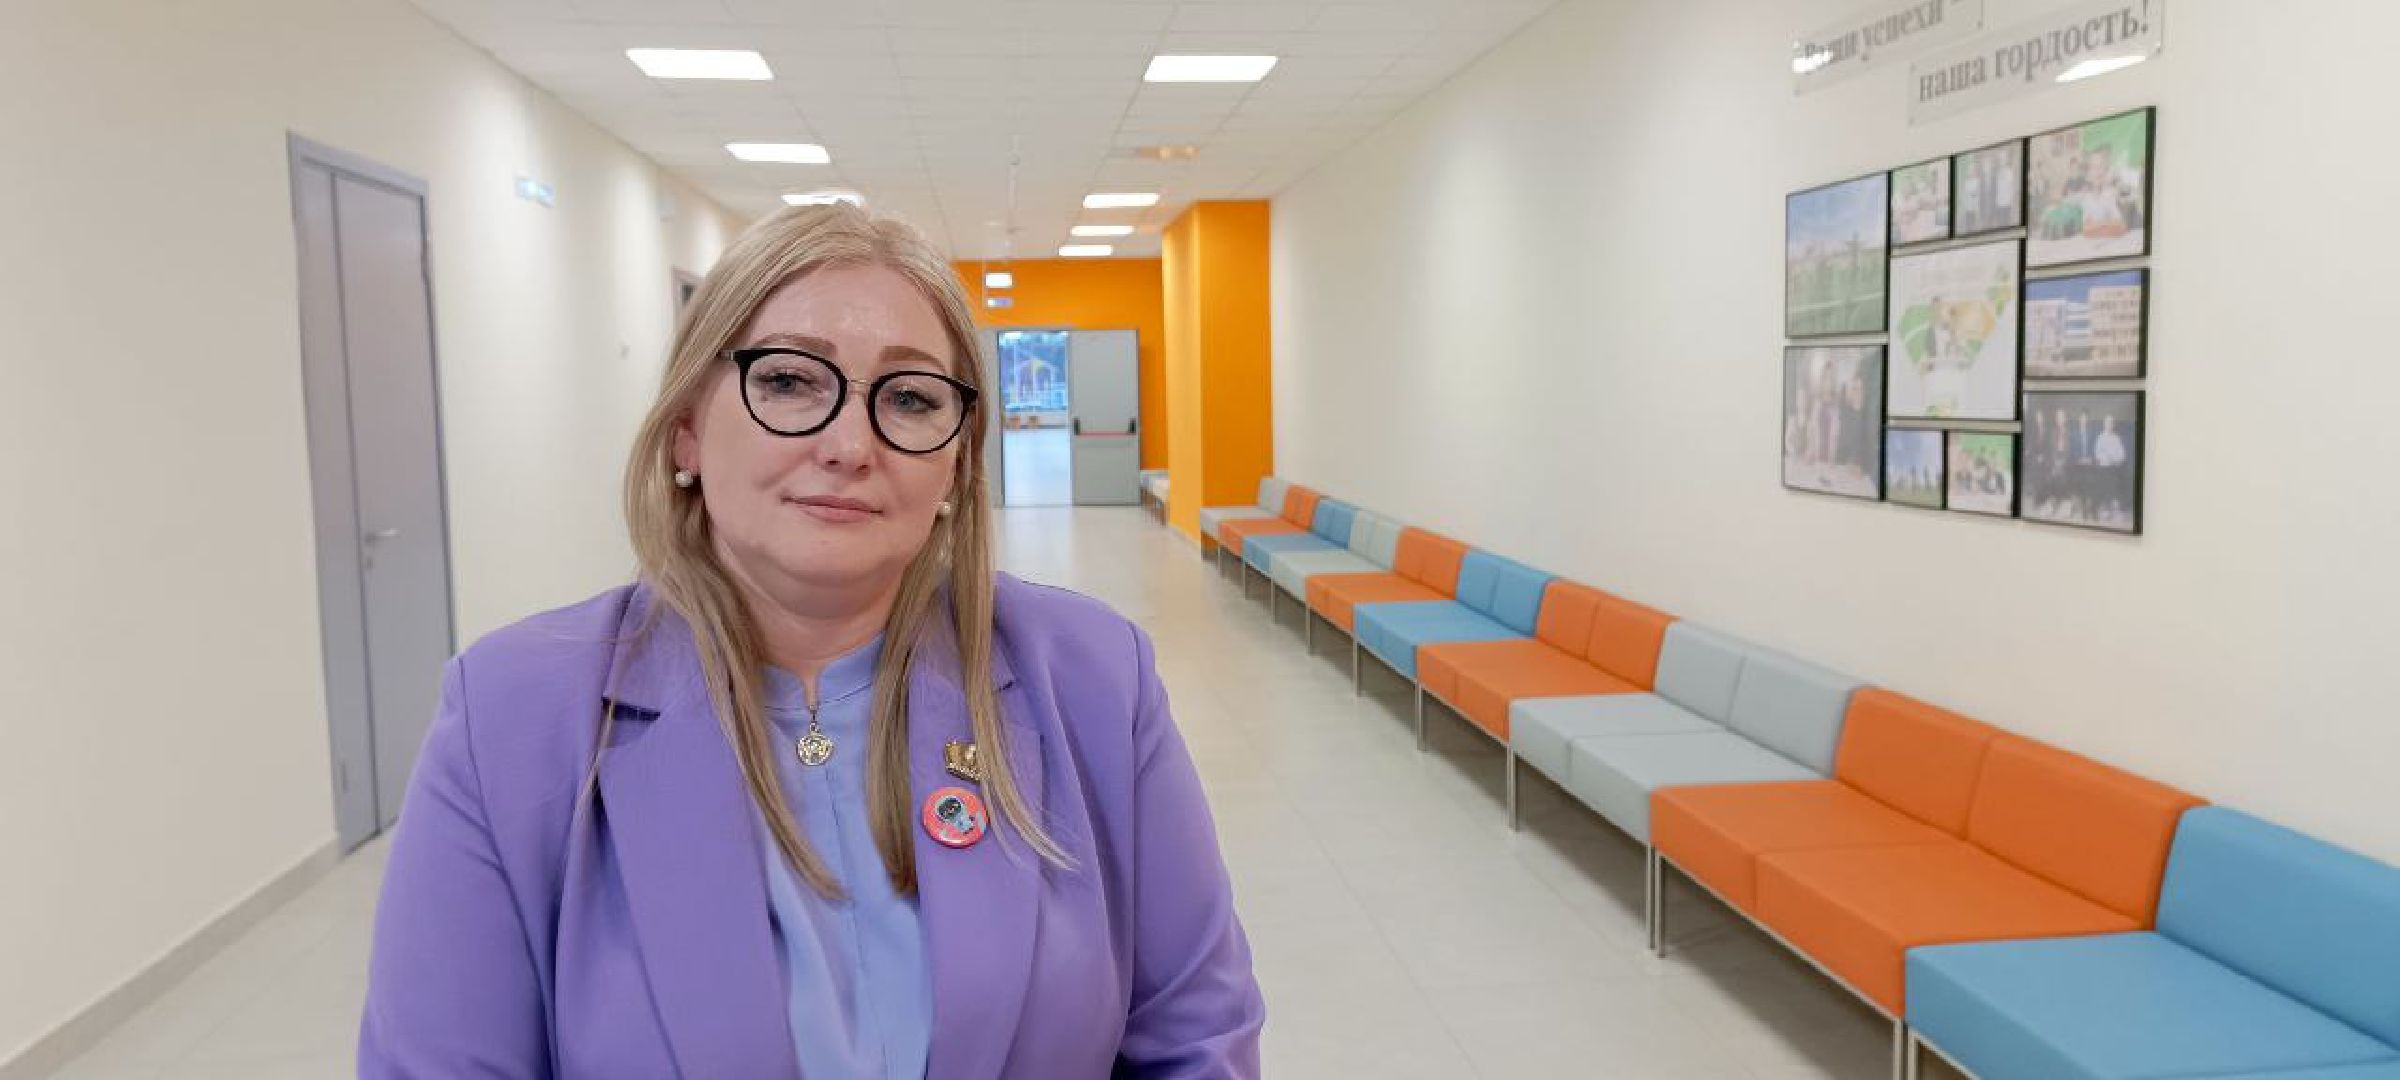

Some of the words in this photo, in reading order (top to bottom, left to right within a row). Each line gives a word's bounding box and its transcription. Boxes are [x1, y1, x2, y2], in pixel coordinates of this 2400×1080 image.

[1860, 0, 1943, 62] успехи
[1919, 56, 1987, 101] наша
[1995, 0, 2148, 81] гордость!
